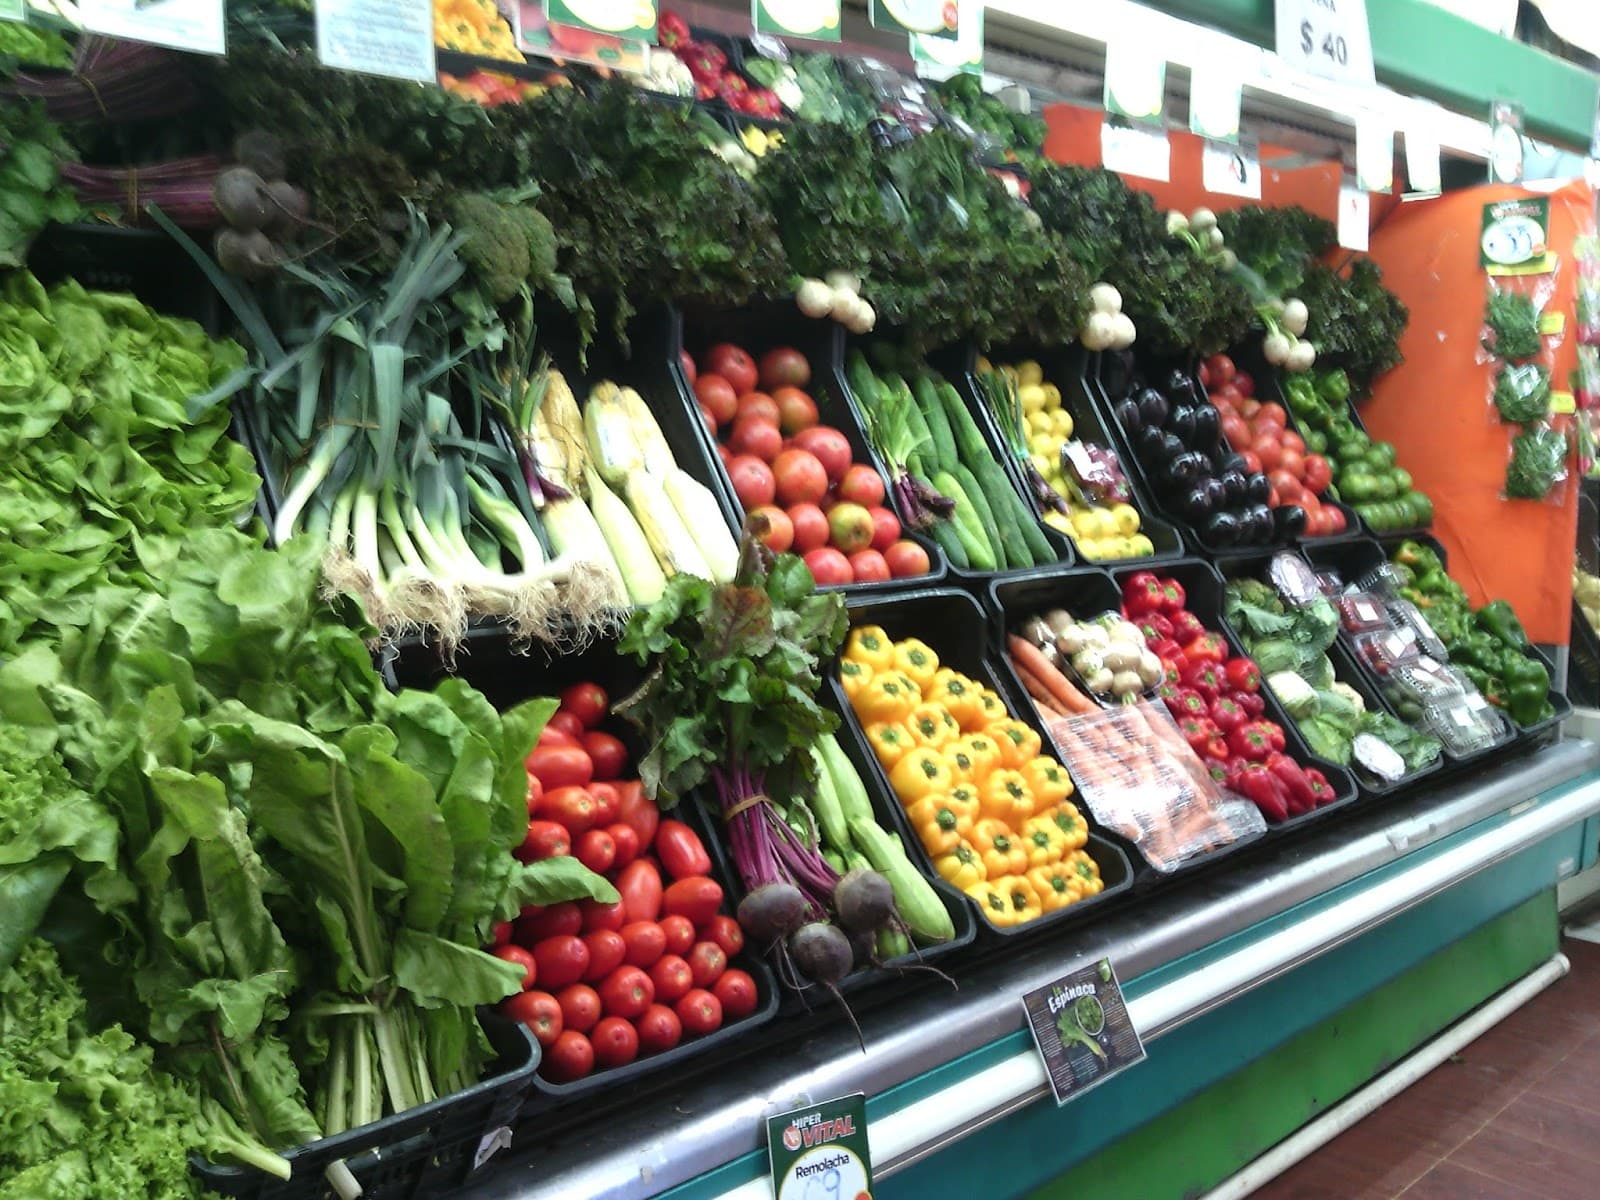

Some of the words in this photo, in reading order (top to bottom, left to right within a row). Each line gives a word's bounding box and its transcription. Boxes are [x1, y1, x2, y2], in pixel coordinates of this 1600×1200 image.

[1321, 32, 1348, 66] 40
[1048, 983, 1096, 1013] Espinaca
[792, 1113, 821, 1128] HIPER
[802, 1115, 856, 1147] VITAL
[796, 1154, 850, 1179] Remolacha
